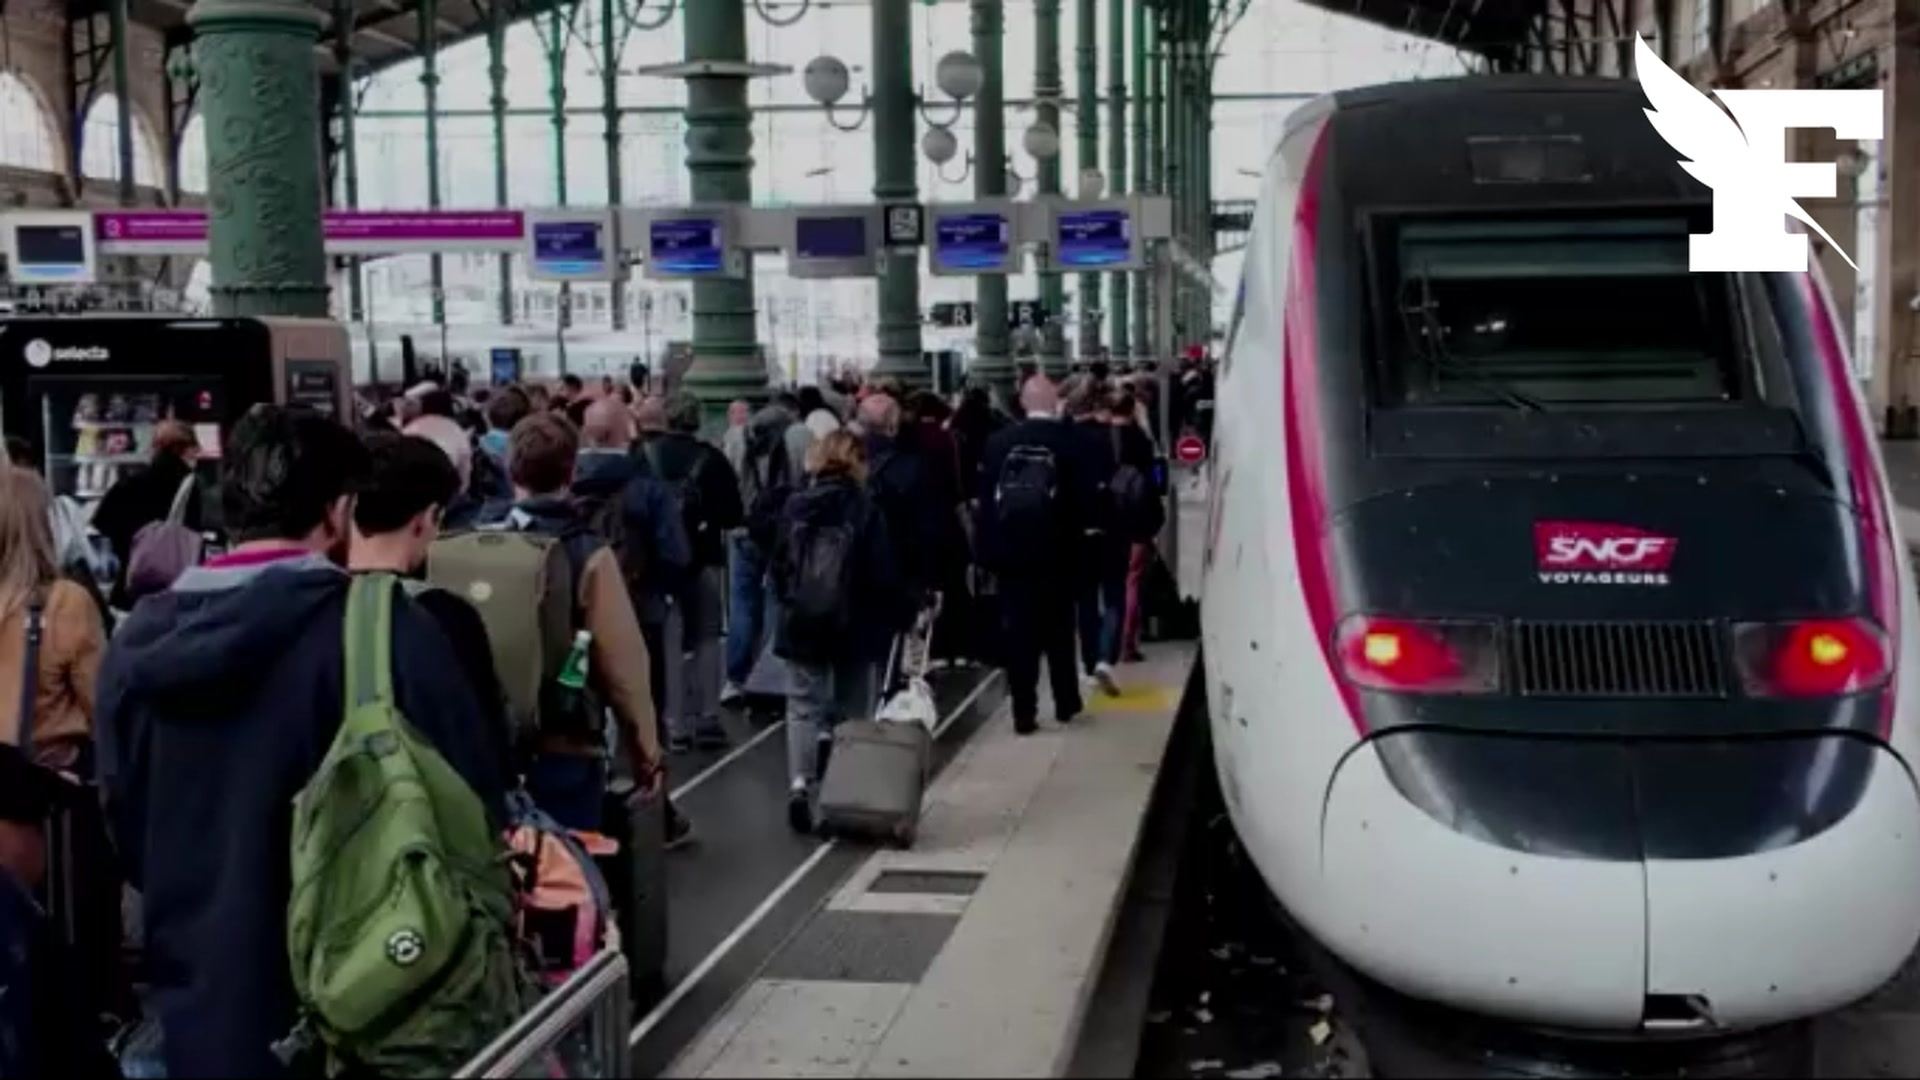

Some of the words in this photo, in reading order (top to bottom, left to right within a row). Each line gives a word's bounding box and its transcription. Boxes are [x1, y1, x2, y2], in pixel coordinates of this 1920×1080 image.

[54, 346, 109, 362] selecta
[1546, 537, 1667, 562] SNCF
[1537, 572, 1670, 584] VOYAGEURS
